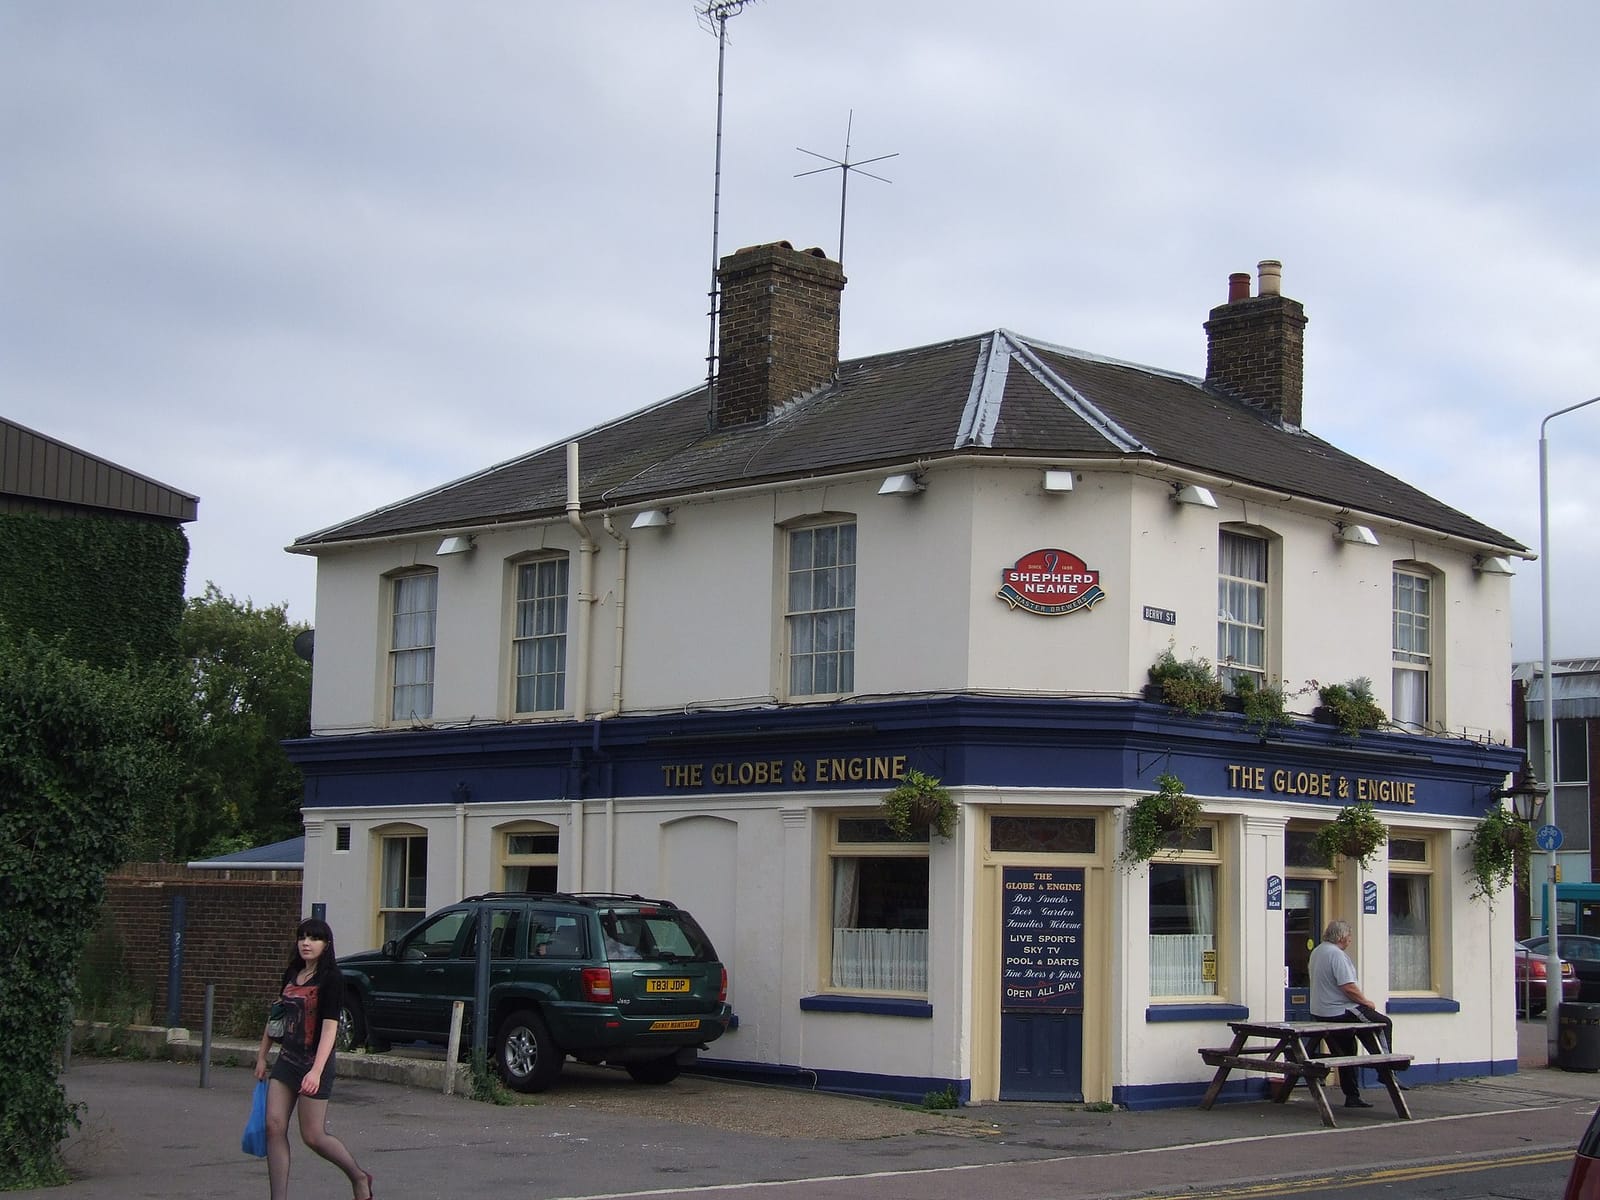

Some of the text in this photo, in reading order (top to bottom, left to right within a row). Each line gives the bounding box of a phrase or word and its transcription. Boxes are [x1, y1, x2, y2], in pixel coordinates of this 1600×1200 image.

[1009, 573, 1093, 583] SHEPHERD
[1025, 584, 1078, 594] NEAME
[1014, 594, 1087, 613] MASTER BREWERS
[661, 755, 907, 787] THE GLOBE & ENGINE
[1228, 765, 1416, 804] THE GLOBE & ENGINE
[1005, 882, 1035, 890] GLOBE
[1046, 883, 1082, 891] ENGINE
[1012, 893, 1032, 902] Bar
[1009, 906, 1075, 917] Beer Garden
[1006, 918, 1082, 929] Families Welcome
[1010, 934, 1076, 943] LIVE SPORTS
[1023, 946, 1043, 954] SKY
[1006, 957, 1033, 965] POOL
[1047, 958, 1080, 966] DARTS
[1004, 968, 1022, 978] Fine
[1023, 968, 1046, 978] Beers
[1056, 969, 1082, 980] Spirits
[651, 980, 686, 991] T831 JDP
[1006, 982, 1076, 998] OPEN ALL DAY
